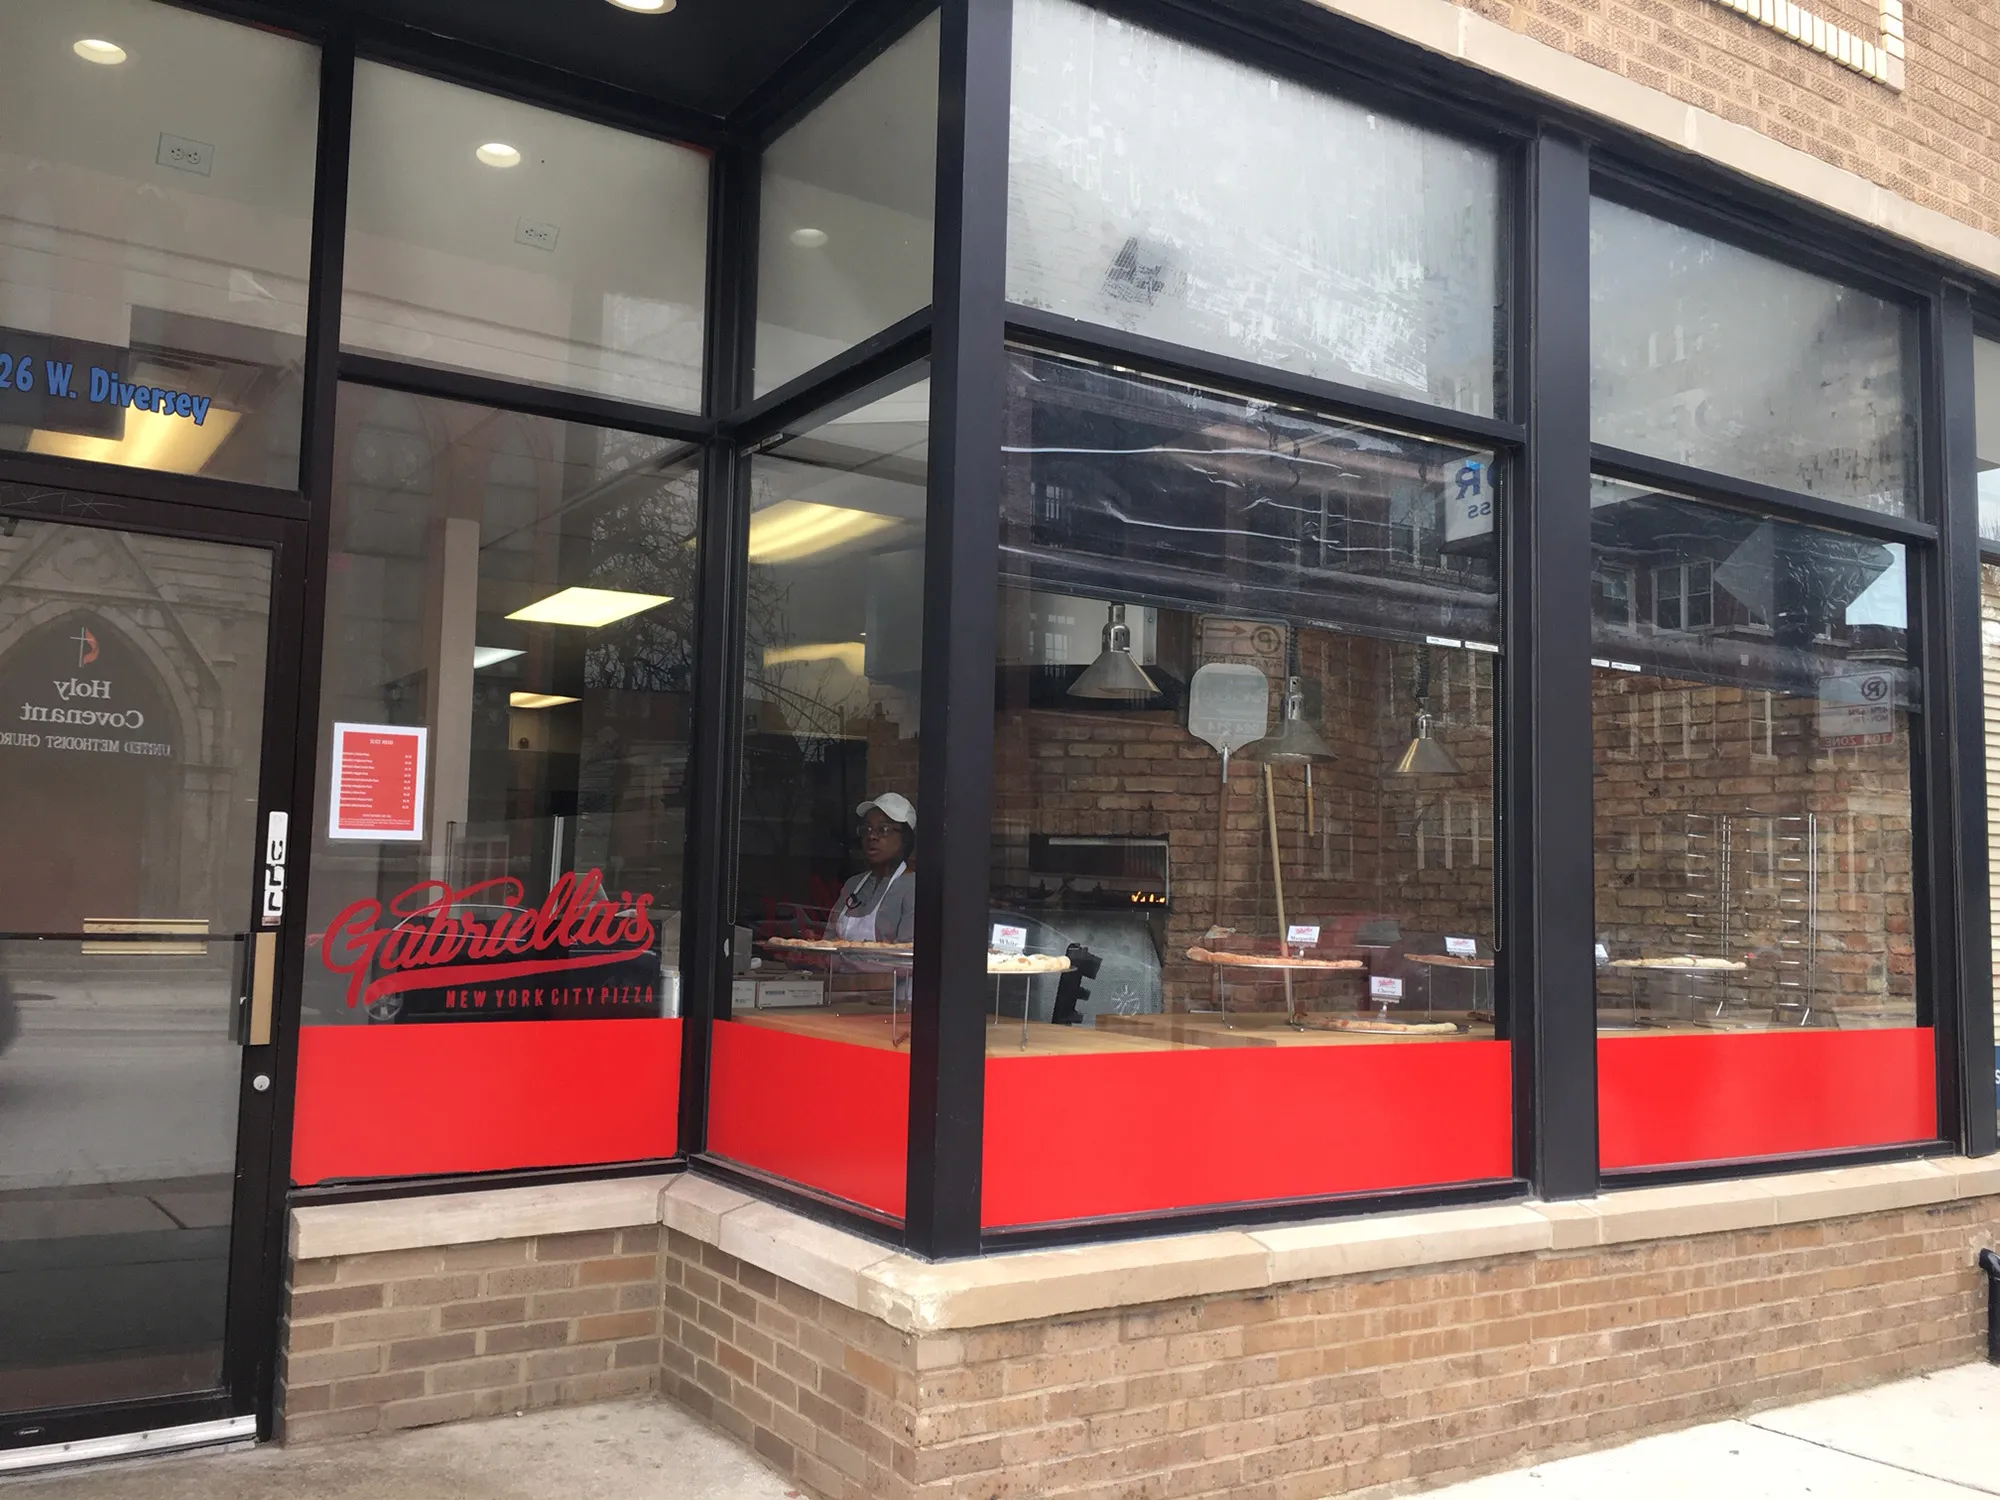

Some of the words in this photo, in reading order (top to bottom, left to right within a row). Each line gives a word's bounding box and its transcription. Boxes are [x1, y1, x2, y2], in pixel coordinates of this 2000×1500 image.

[45, 360, 77, 399] W.
[90, 367, 211, 426] Diversey
[267, 814, 284, 912] ULL
[322, 868, 655, 1008] Gabriella's
[446, 990, 487, 1009] NEW
[496, 989, 544, 1008] YORK
[551, 987, 594, 1006] CITY
[600, 985, 653, 1004] PIZZA
